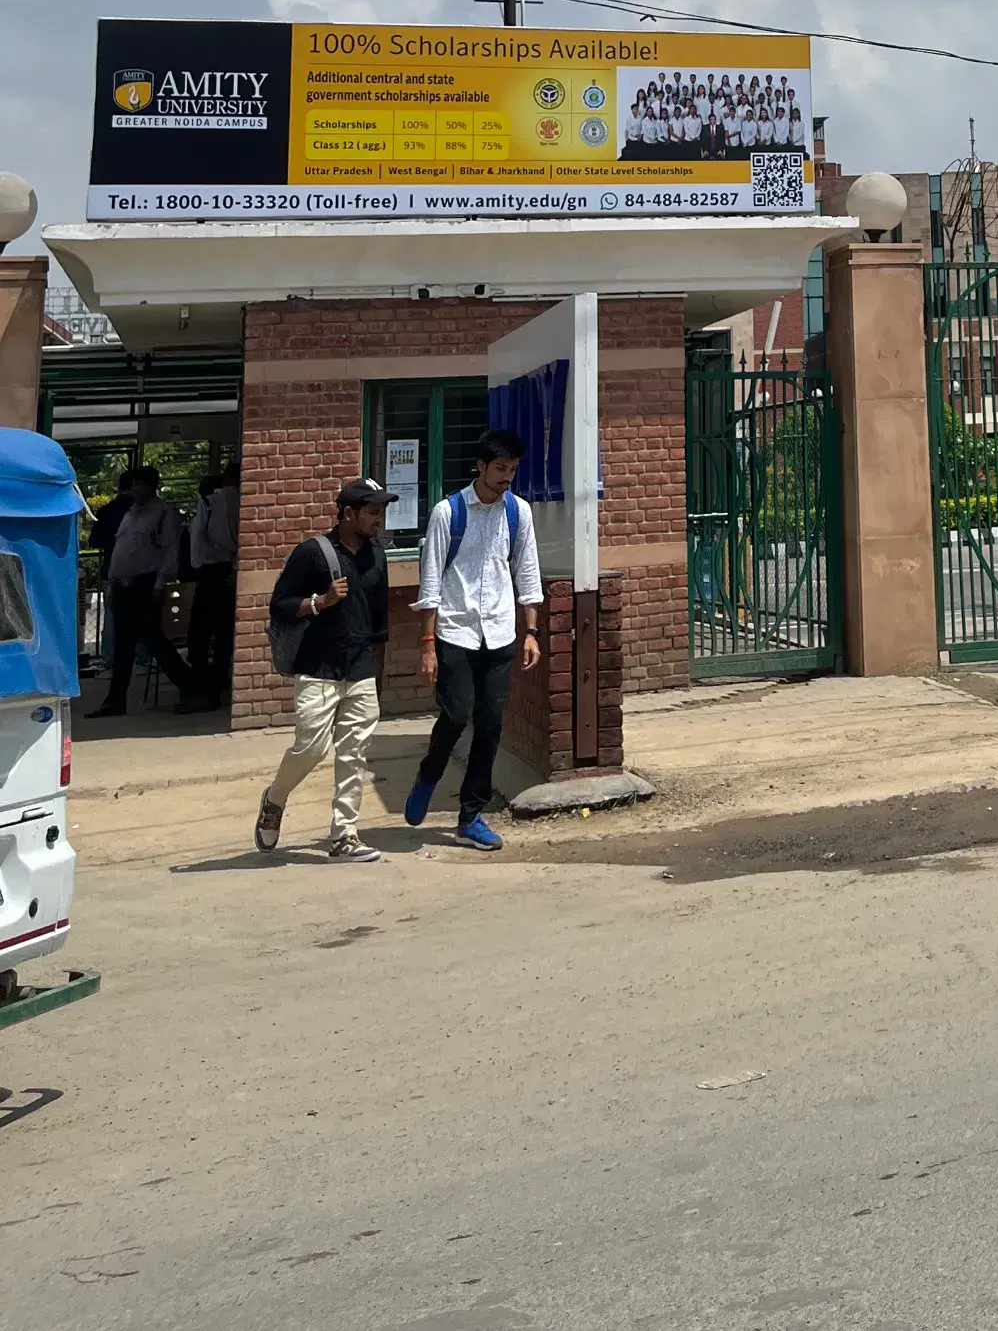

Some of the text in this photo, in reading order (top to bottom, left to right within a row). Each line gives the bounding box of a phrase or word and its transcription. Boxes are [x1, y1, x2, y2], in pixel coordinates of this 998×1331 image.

[309, 33, 658, 62] 100% Scholarships Available!
[156, 70, 269, 98] AMITY
[307, 71, 455, 85] Additional central and state
[306, 90, 490, 104] government scholarships available
[157, 99, 268, 115] UNIVERSITY
[116, 117, 264, 128] GREATER NOIDA CAMPUS
[313, 120, 503, 131] Scholarships 100% 50% 25%
[313, 141, 340, 150] Class
[343, 141, 354, 150] 12
[404, 142, 426, 150] 93%
[445, 142, 467, 150] 88%
[481, 142, 503, 151] 75%
[304, 166, 693, 177] Uttar Pradesh West Bengal Bihar & Jharkhand Other State Level Scholarships
[108, 194, 148, 210] Tel.:
[155, 194, 300, 210] 1800-10-33320
[306, 193, 398, 211] (Toll-free)
[425, 192, 587, 211] www.amity.edu/gn
[624, 192, 739, 208] 84-484-82587
